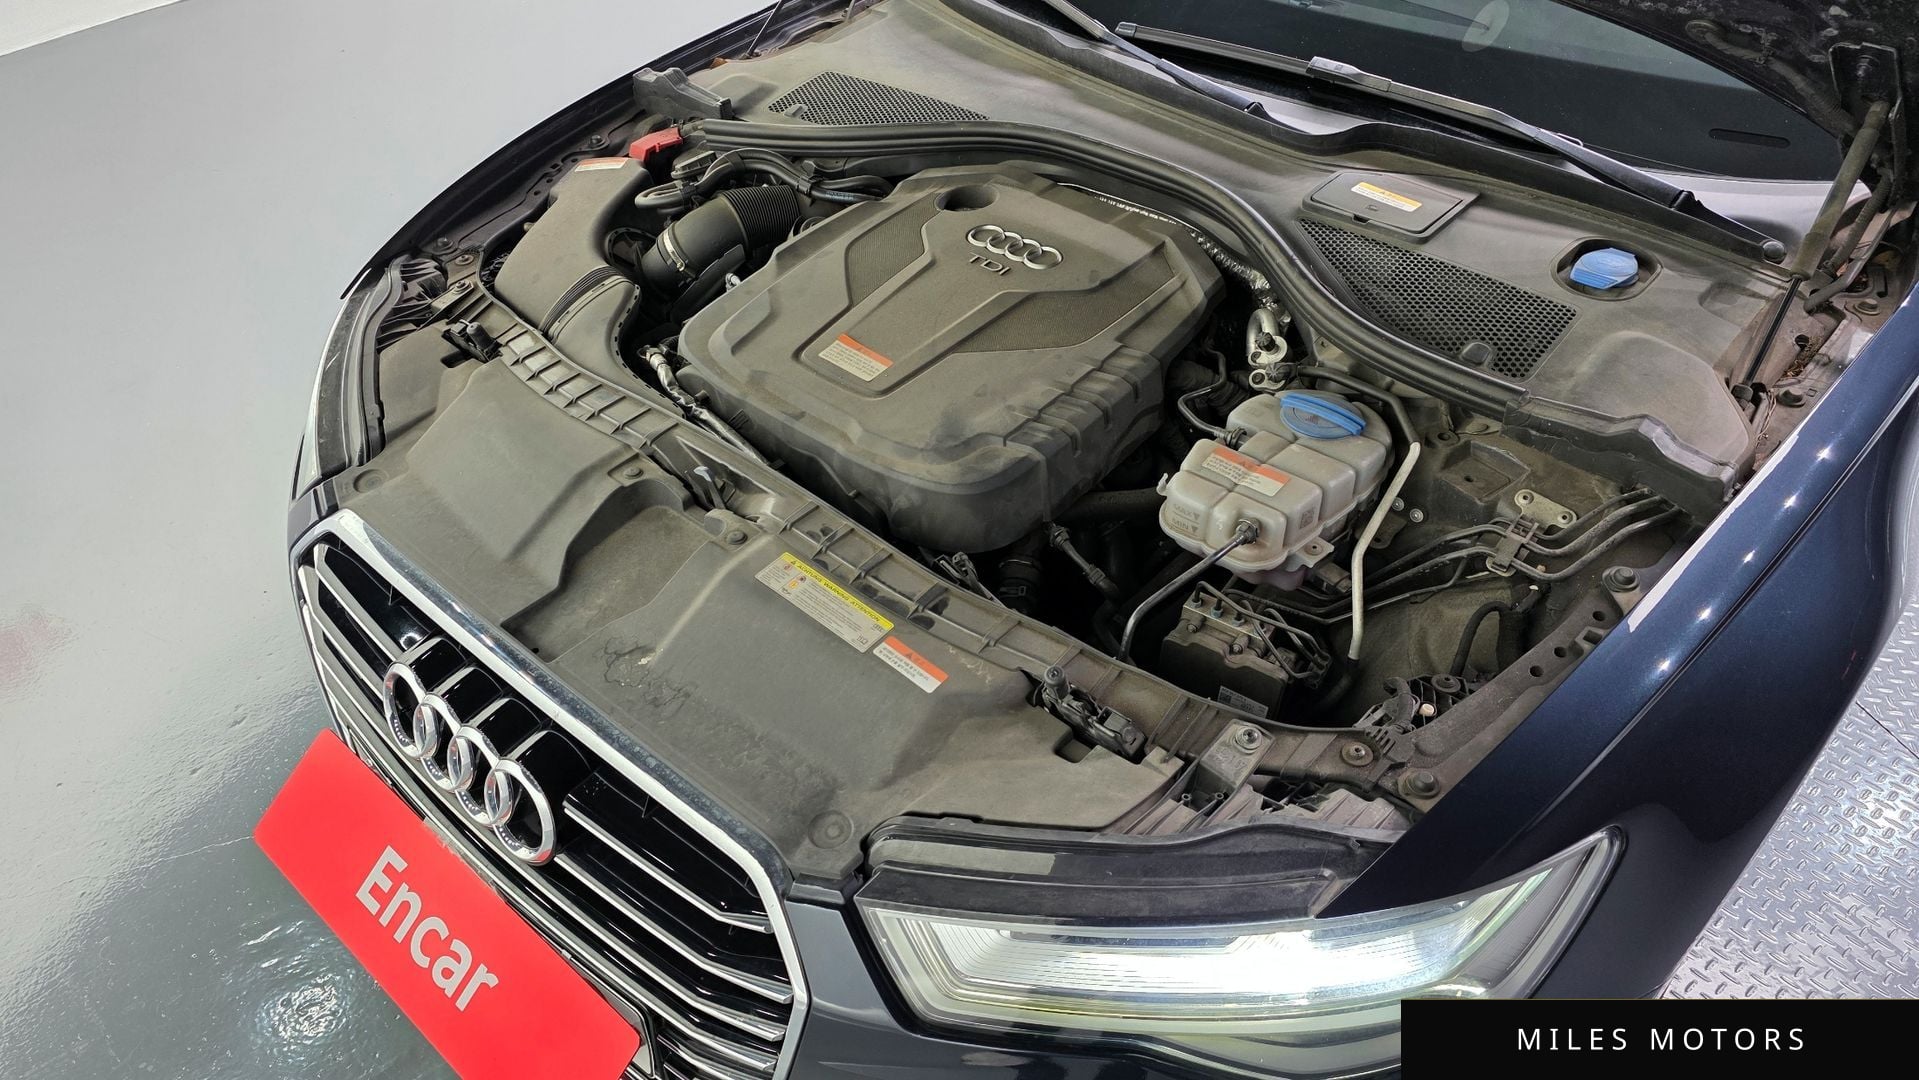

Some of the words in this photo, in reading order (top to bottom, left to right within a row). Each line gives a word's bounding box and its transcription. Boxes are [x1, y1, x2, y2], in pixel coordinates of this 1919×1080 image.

[969, 252, 1011, 276] TDI
[797, 564, 823, 583] ACHTUNG
[823, 581, 850, 602] WARNING
[850, 600, 880, 623] ATTENTION
[355, 845, 499, 1012] Encar
